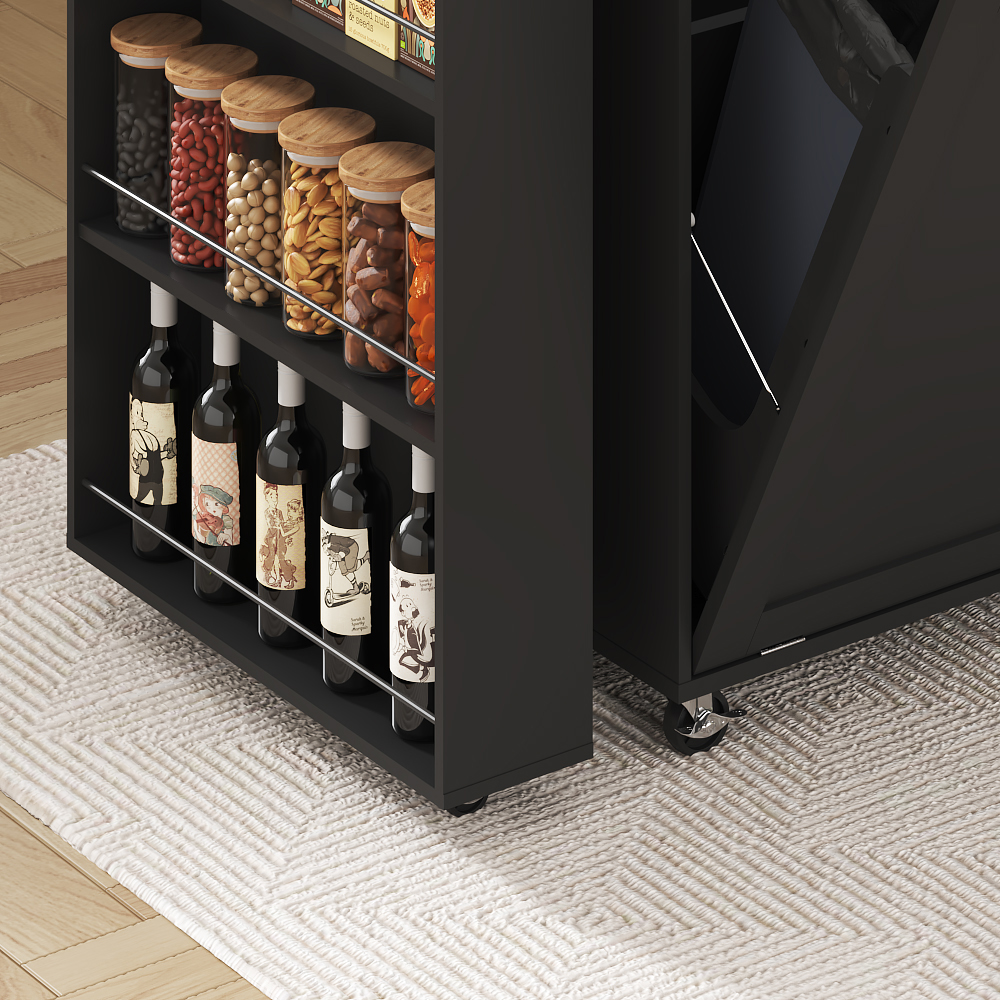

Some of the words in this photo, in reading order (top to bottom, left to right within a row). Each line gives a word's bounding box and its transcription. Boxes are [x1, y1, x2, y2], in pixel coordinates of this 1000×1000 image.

[349, 1, 373, 20] roasted
[375, 15, 390, 28] nuts
[349, 12, 354, 22] &
[356, 17, 374, 32] seeds
